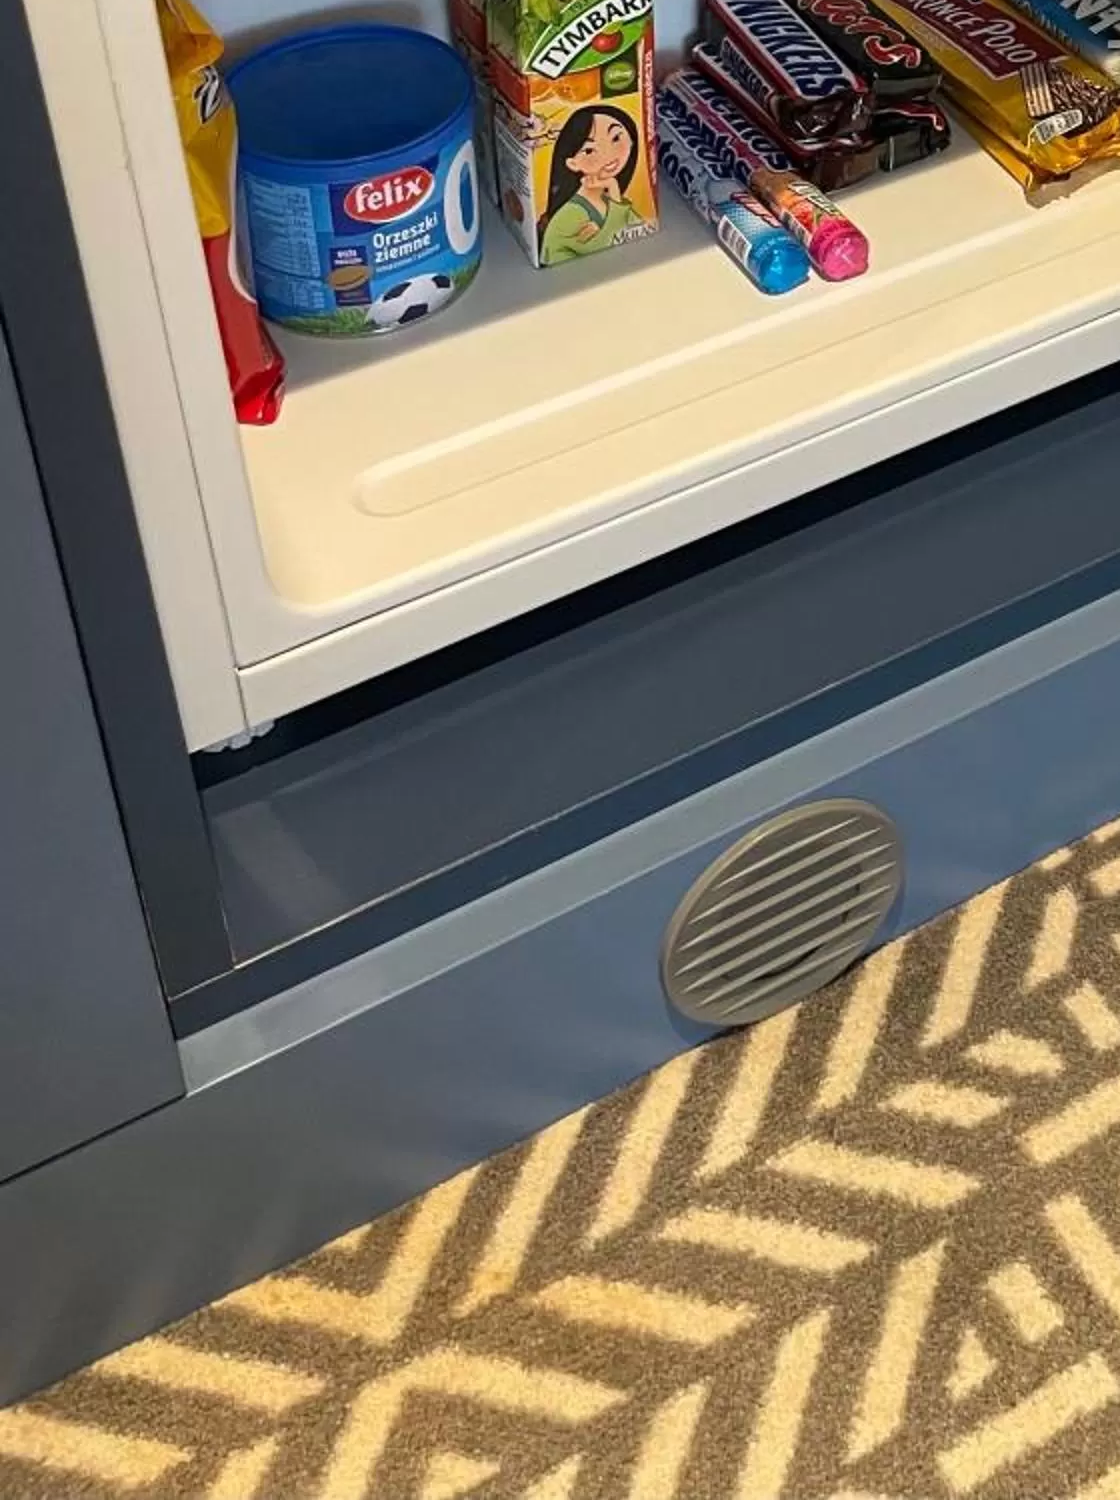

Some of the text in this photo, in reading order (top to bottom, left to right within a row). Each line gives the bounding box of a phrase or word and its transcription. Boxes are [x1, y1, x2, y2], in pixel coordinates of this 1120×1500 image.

[966, 17, 1038, 64] POLO
[354, 175, 424, 214] felix
[373, 211, 439, 248] Orzeszki
[374, 236, 432, 264] ziemne
